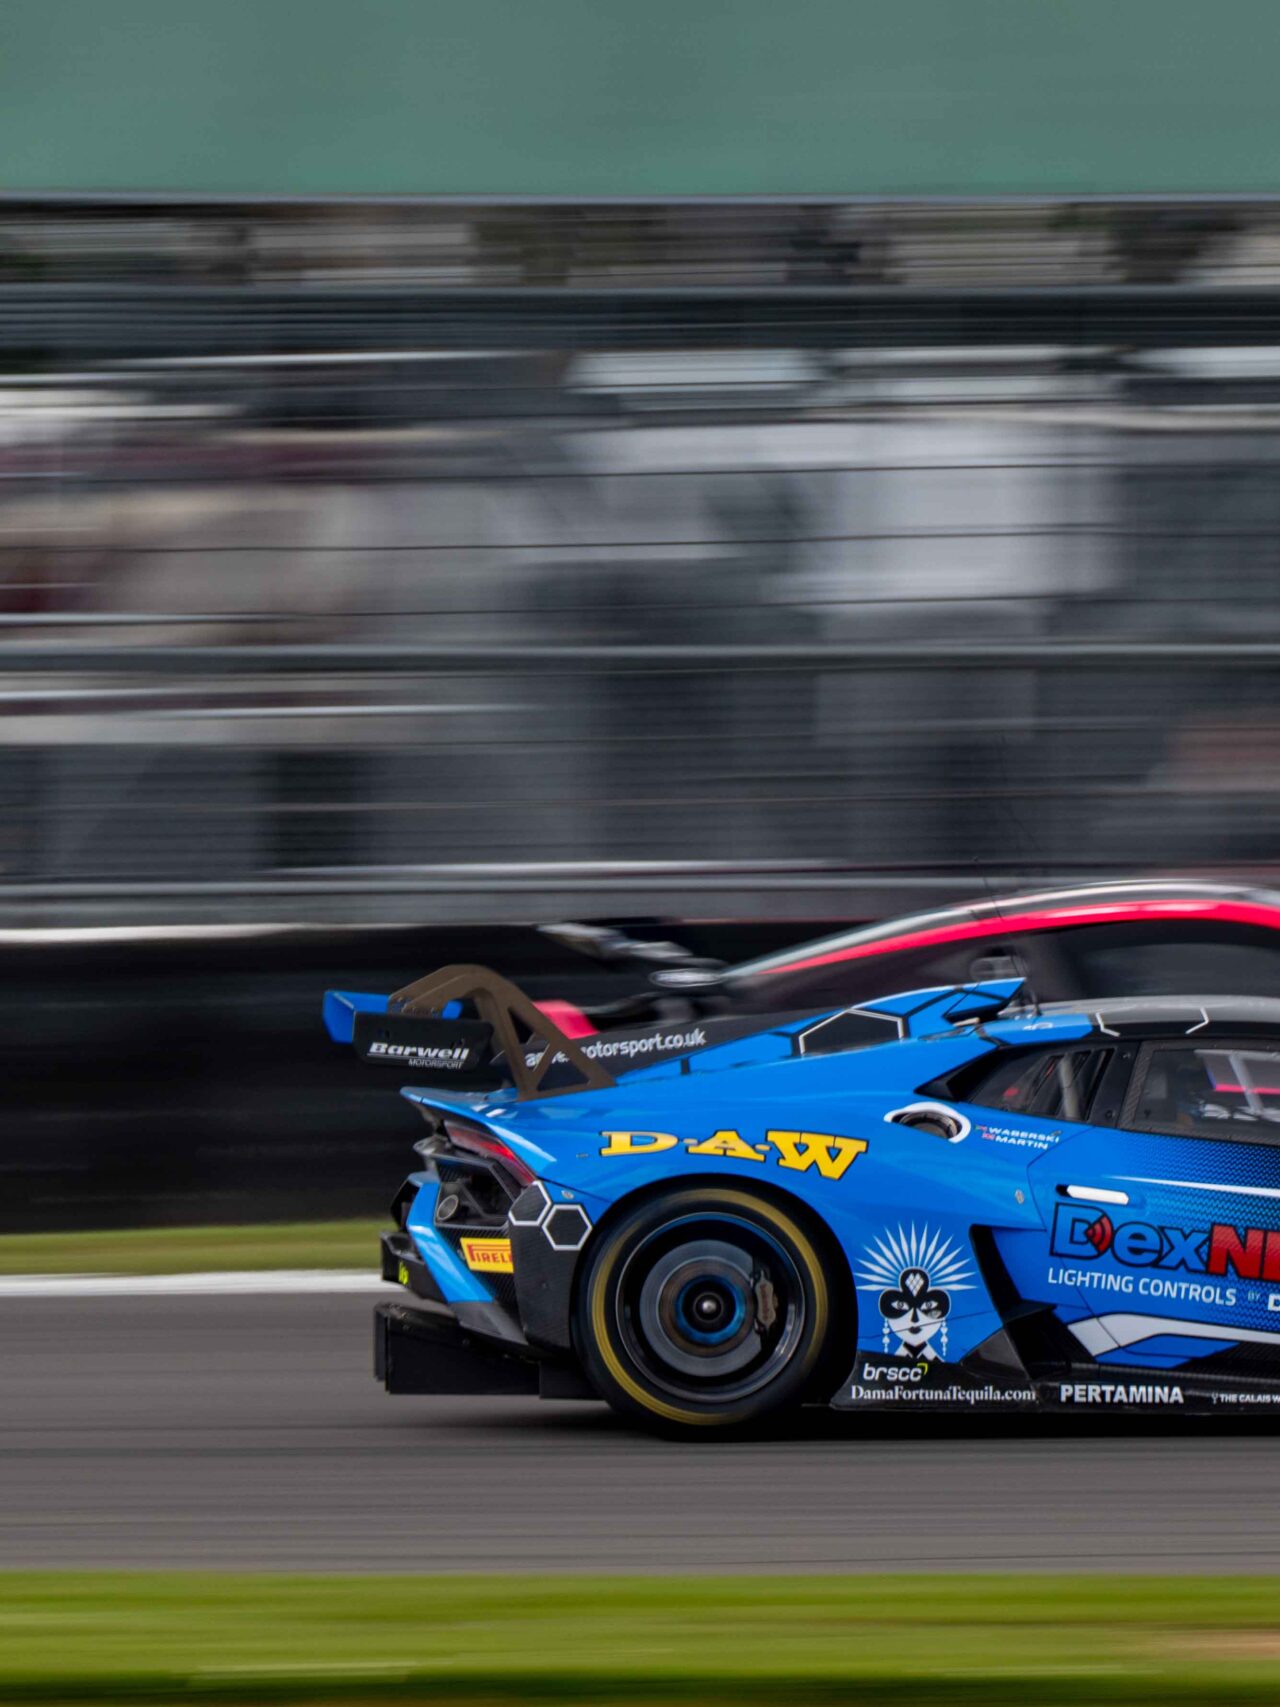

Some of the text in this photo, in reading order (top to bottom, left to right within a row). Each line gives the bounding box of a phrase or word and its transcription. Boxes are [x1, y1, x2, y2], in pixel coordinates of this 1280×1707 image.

[369, 1042, 470, 1060] Barwell
[408, 1059, 464, 1069] MOTORSPORT
[989, 1127, 1060, 1143] WABERSKI
[995, 1136, 1048, 1150] MARTIN
[1048, 1267, 1133, 1293] LIGHTING
[1138, 1278, 1237, 1306] CONTROLS
[1248, 1291, 1261, 1300] BY
[862, 1363, 923, 1382] brscc
[851, 1385, 1037, 1404] DamaFortunaTequila.com
[1060, 1384, 1184, 1403] PERTAMINA
[1220, 1393, 1237, 1403] THE
[1239, 1393, 1271, 1403] CALAIS
